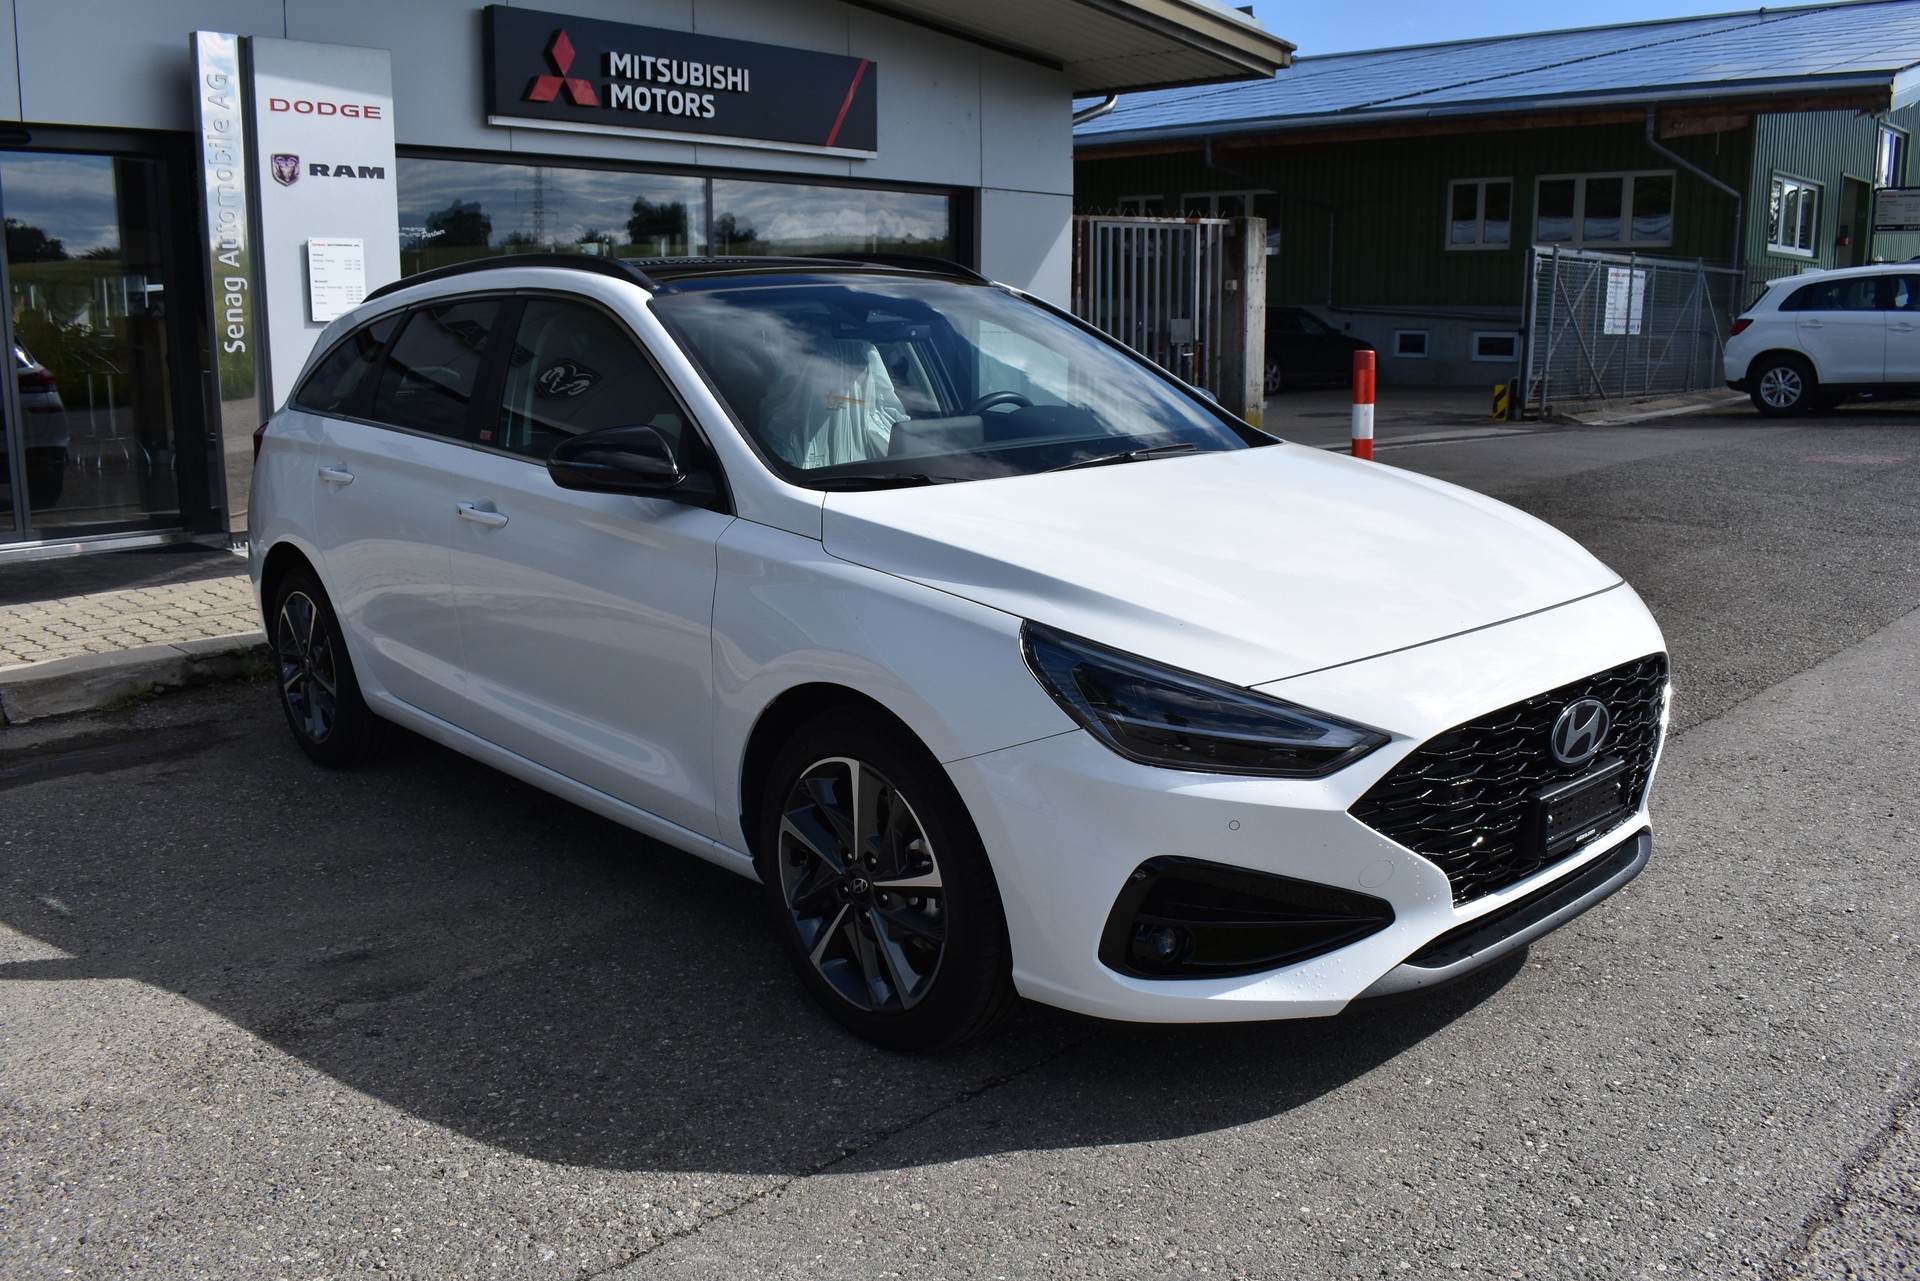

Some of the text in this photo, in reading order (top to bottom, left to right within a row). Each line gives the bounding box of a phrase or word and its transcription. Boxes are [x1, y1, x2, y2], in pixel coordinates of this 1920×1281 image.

[609, 51, 750, 92] MITSUBISHI
[269, 98, 382, 120] DODGE
[610, 83, 716, 119] MOTORS
[309, 163, 385, 179] RAM
[206, 72, 248, 353] Senag Automobile AG
